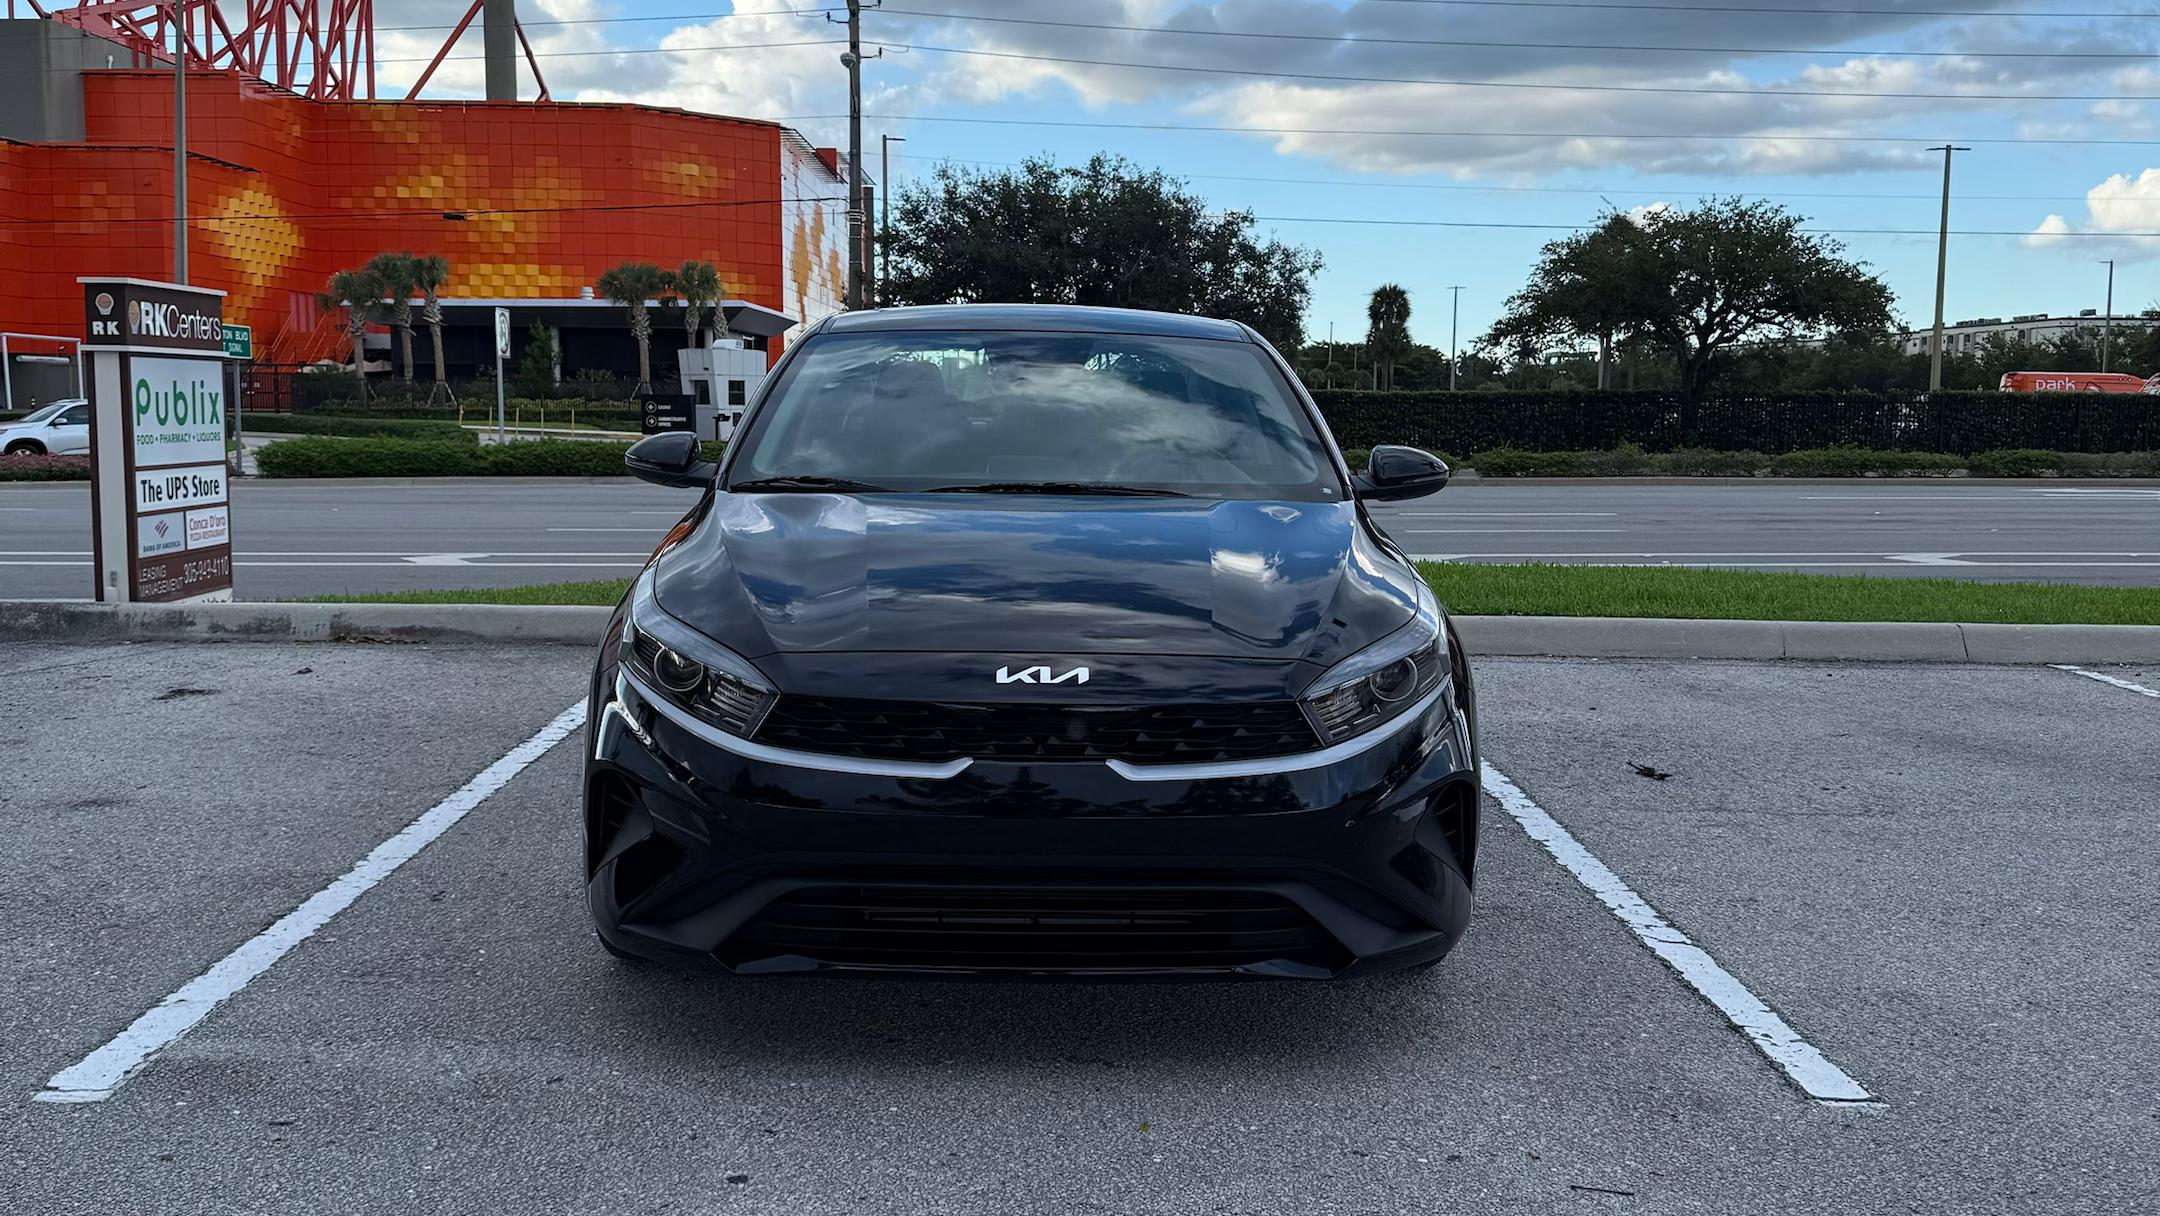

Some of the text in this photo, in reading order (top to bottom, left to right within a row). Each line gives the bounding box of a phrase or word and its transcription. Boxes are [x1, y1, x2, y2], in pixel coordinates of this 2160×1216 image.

[92, 321, 120, 335] RK
[135, 378, 221, 427] Publix
[137, 434, 154, 445] FOOD
[159, 433, 191, 444] PHARMACY
[141, 474, 220, 503] The UPS Store
[139, 564, 167, 582] LEASING
